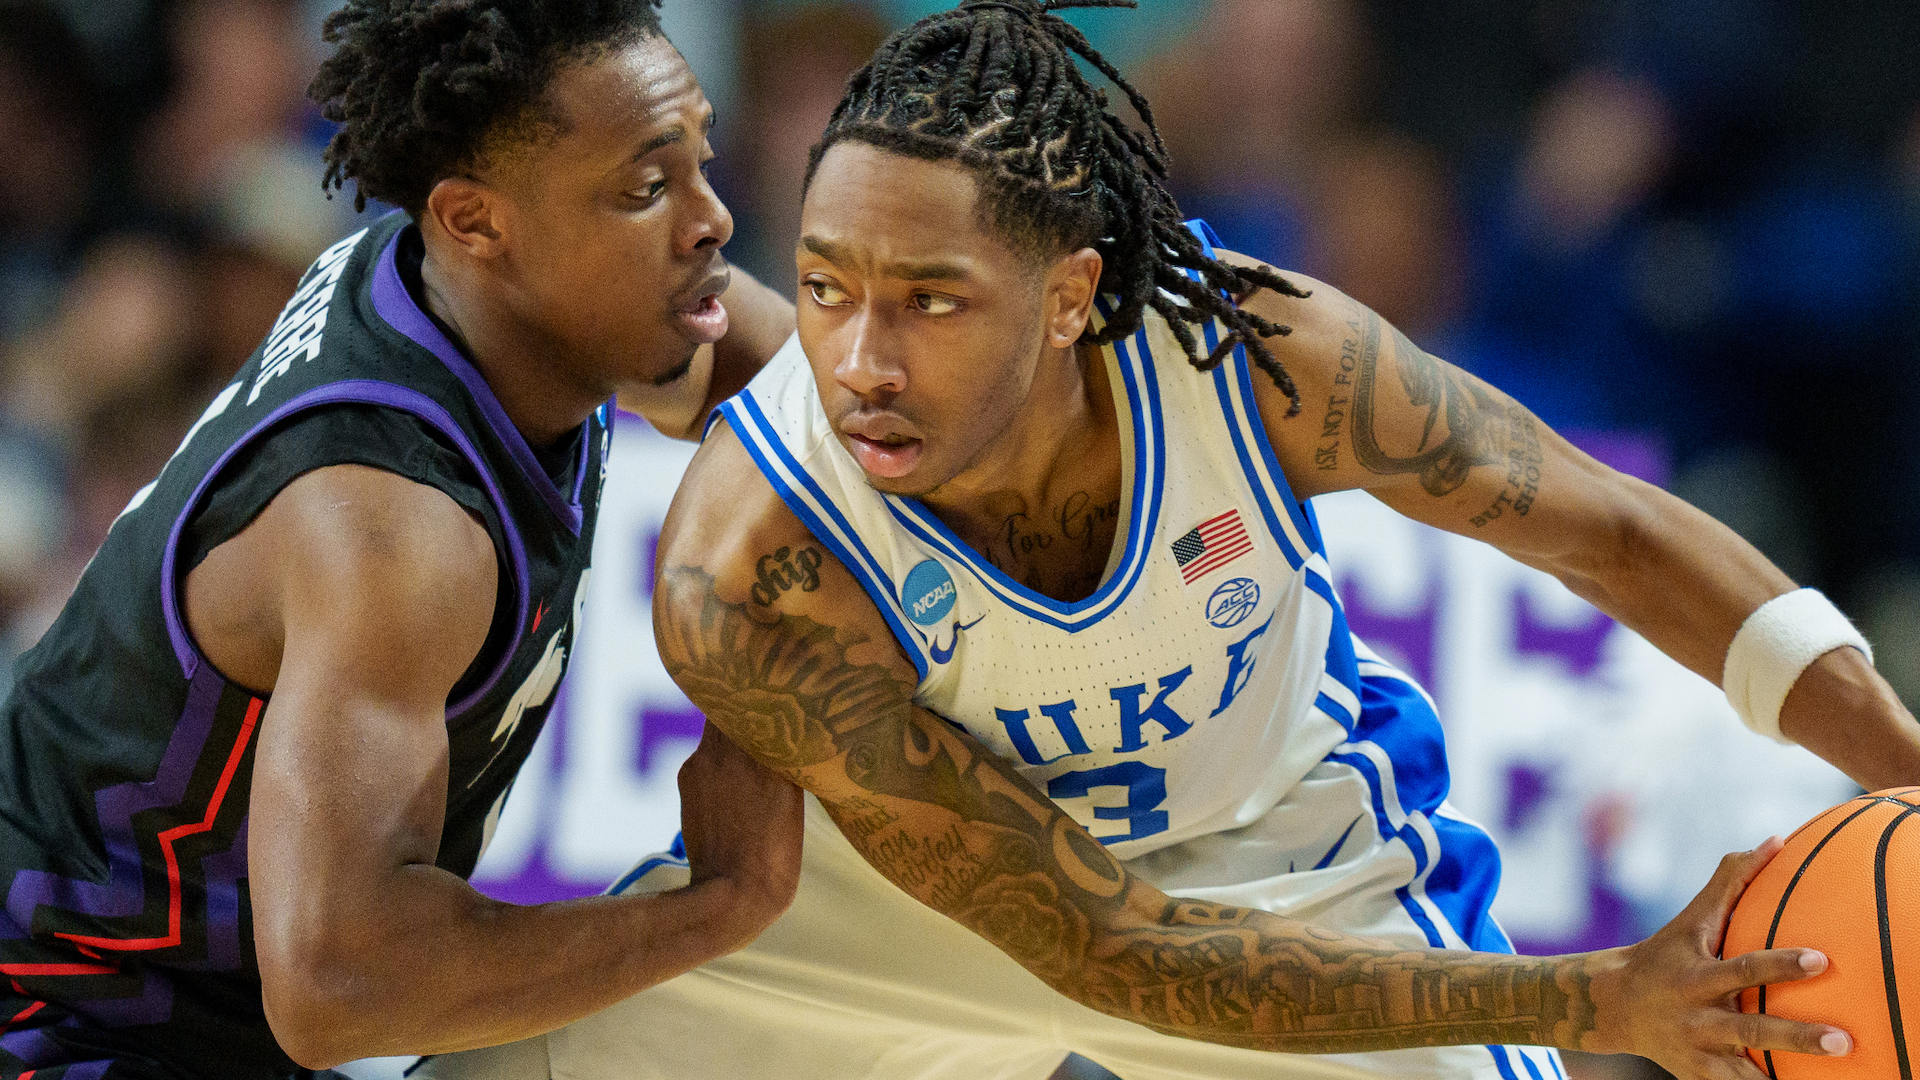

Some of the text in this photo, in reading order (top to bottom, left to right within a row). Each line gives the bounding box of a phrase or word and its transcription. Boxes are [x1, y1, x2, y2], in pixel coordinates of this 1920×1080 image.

[1334, 338, 1360, 387] FOR
[1321, 395, 1349, 440] NOT
[1314, 441, 1340, 471] ASK
[1469, 490, 1512, 528] BUT
[1507, 449, 1525, 488] FOR
[912, 580, 956, 618] NCAA
[1213, 583, 1256, 615] ACC
[995, 609, 1275, 766] UKE
[1047, 760, 1169, 846] 3
